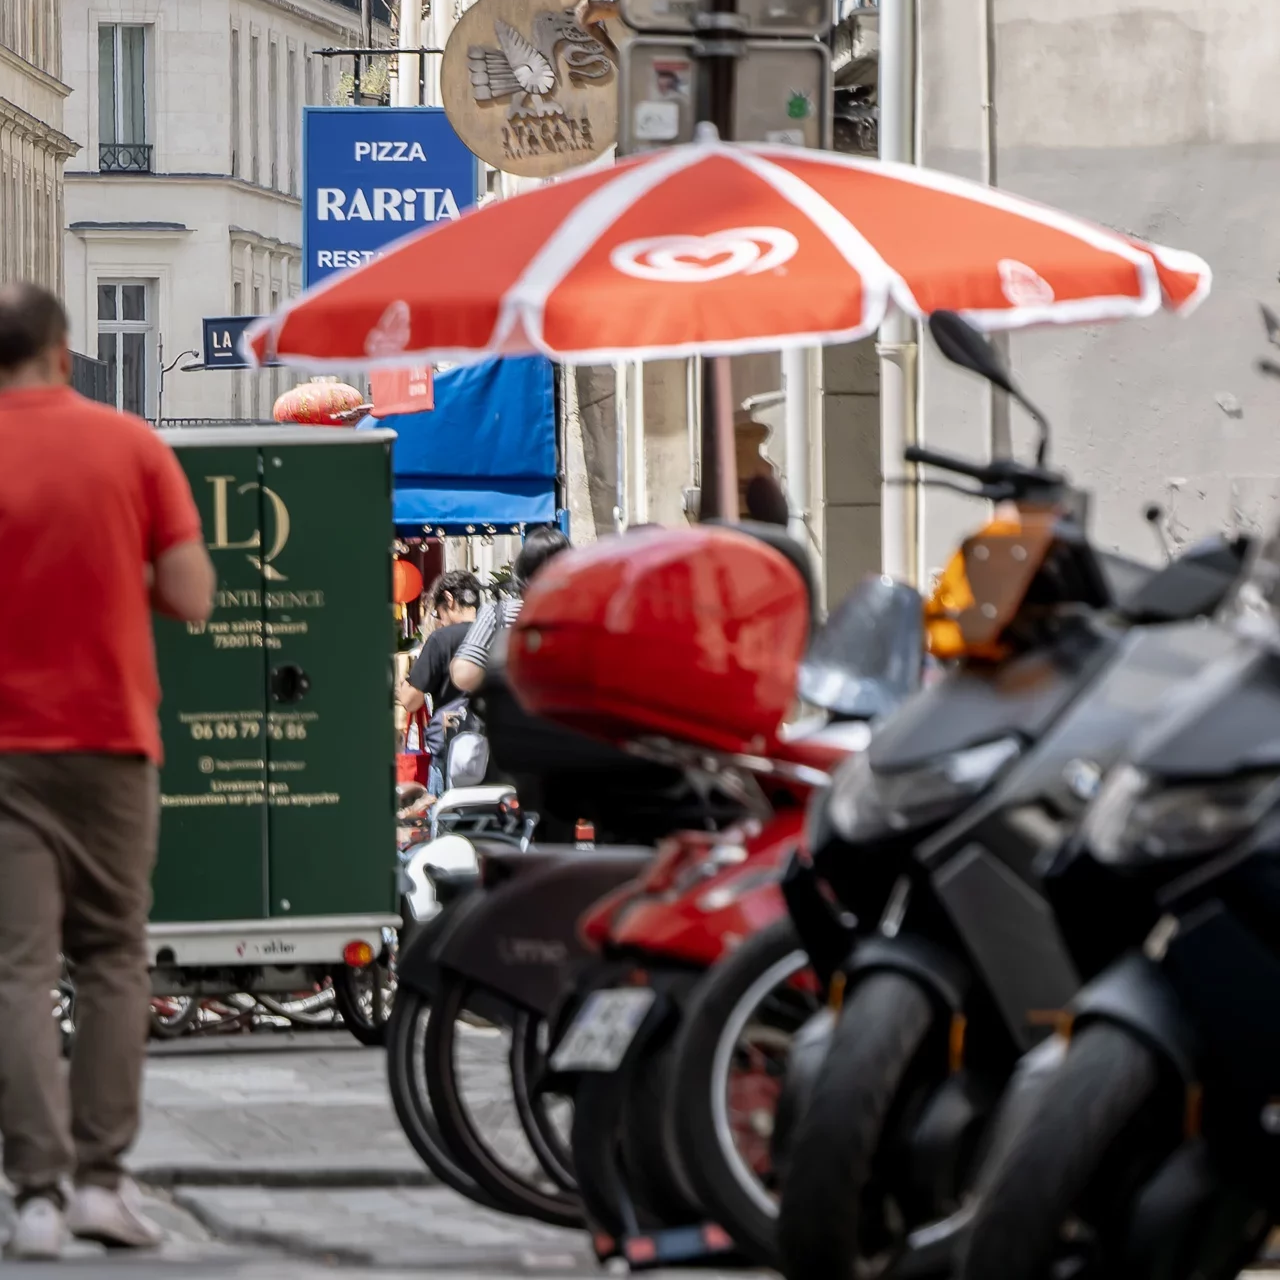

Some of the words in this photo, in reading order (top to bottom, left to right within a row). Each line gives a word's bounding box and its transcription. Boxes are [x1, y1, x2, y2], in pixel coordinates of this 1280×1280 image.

[355, 142, 427, 161] PIZZA
[317, 250, 386, 268] REST
[212, 331, 232, 349] LA
